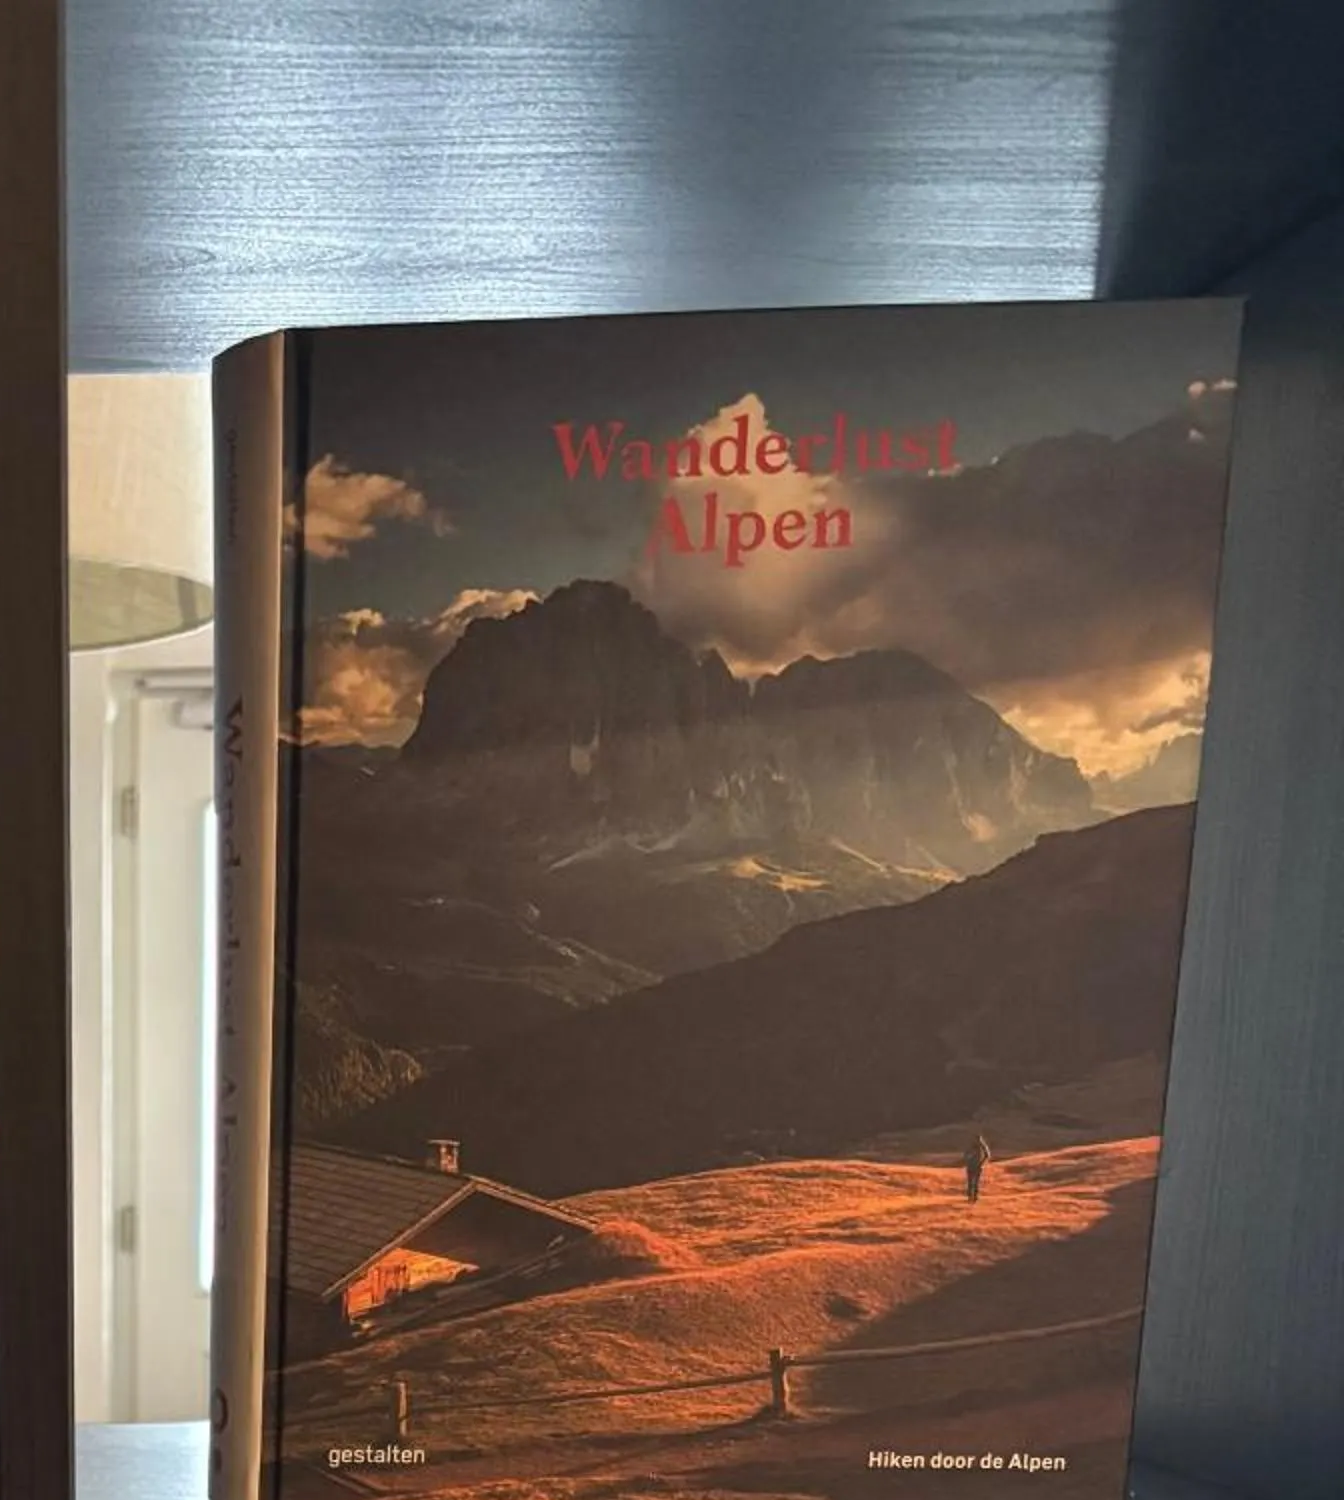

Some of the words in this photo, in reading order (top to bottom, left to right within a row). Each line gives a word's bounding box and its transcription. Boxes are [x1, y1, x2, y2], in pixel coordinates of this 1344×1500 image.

[553, 411, 957, 481] Wanderlust
[646, 492, 854, 569] Alpen
[328, 1444, 425, 1467] gestalten
[868, 1451, 925, 1468] Hiken
[930, 1451, 975, 1469] door
[980, 1452, 1004, 1469] de
[1008, 1453, 1067, 1473] Alpen
